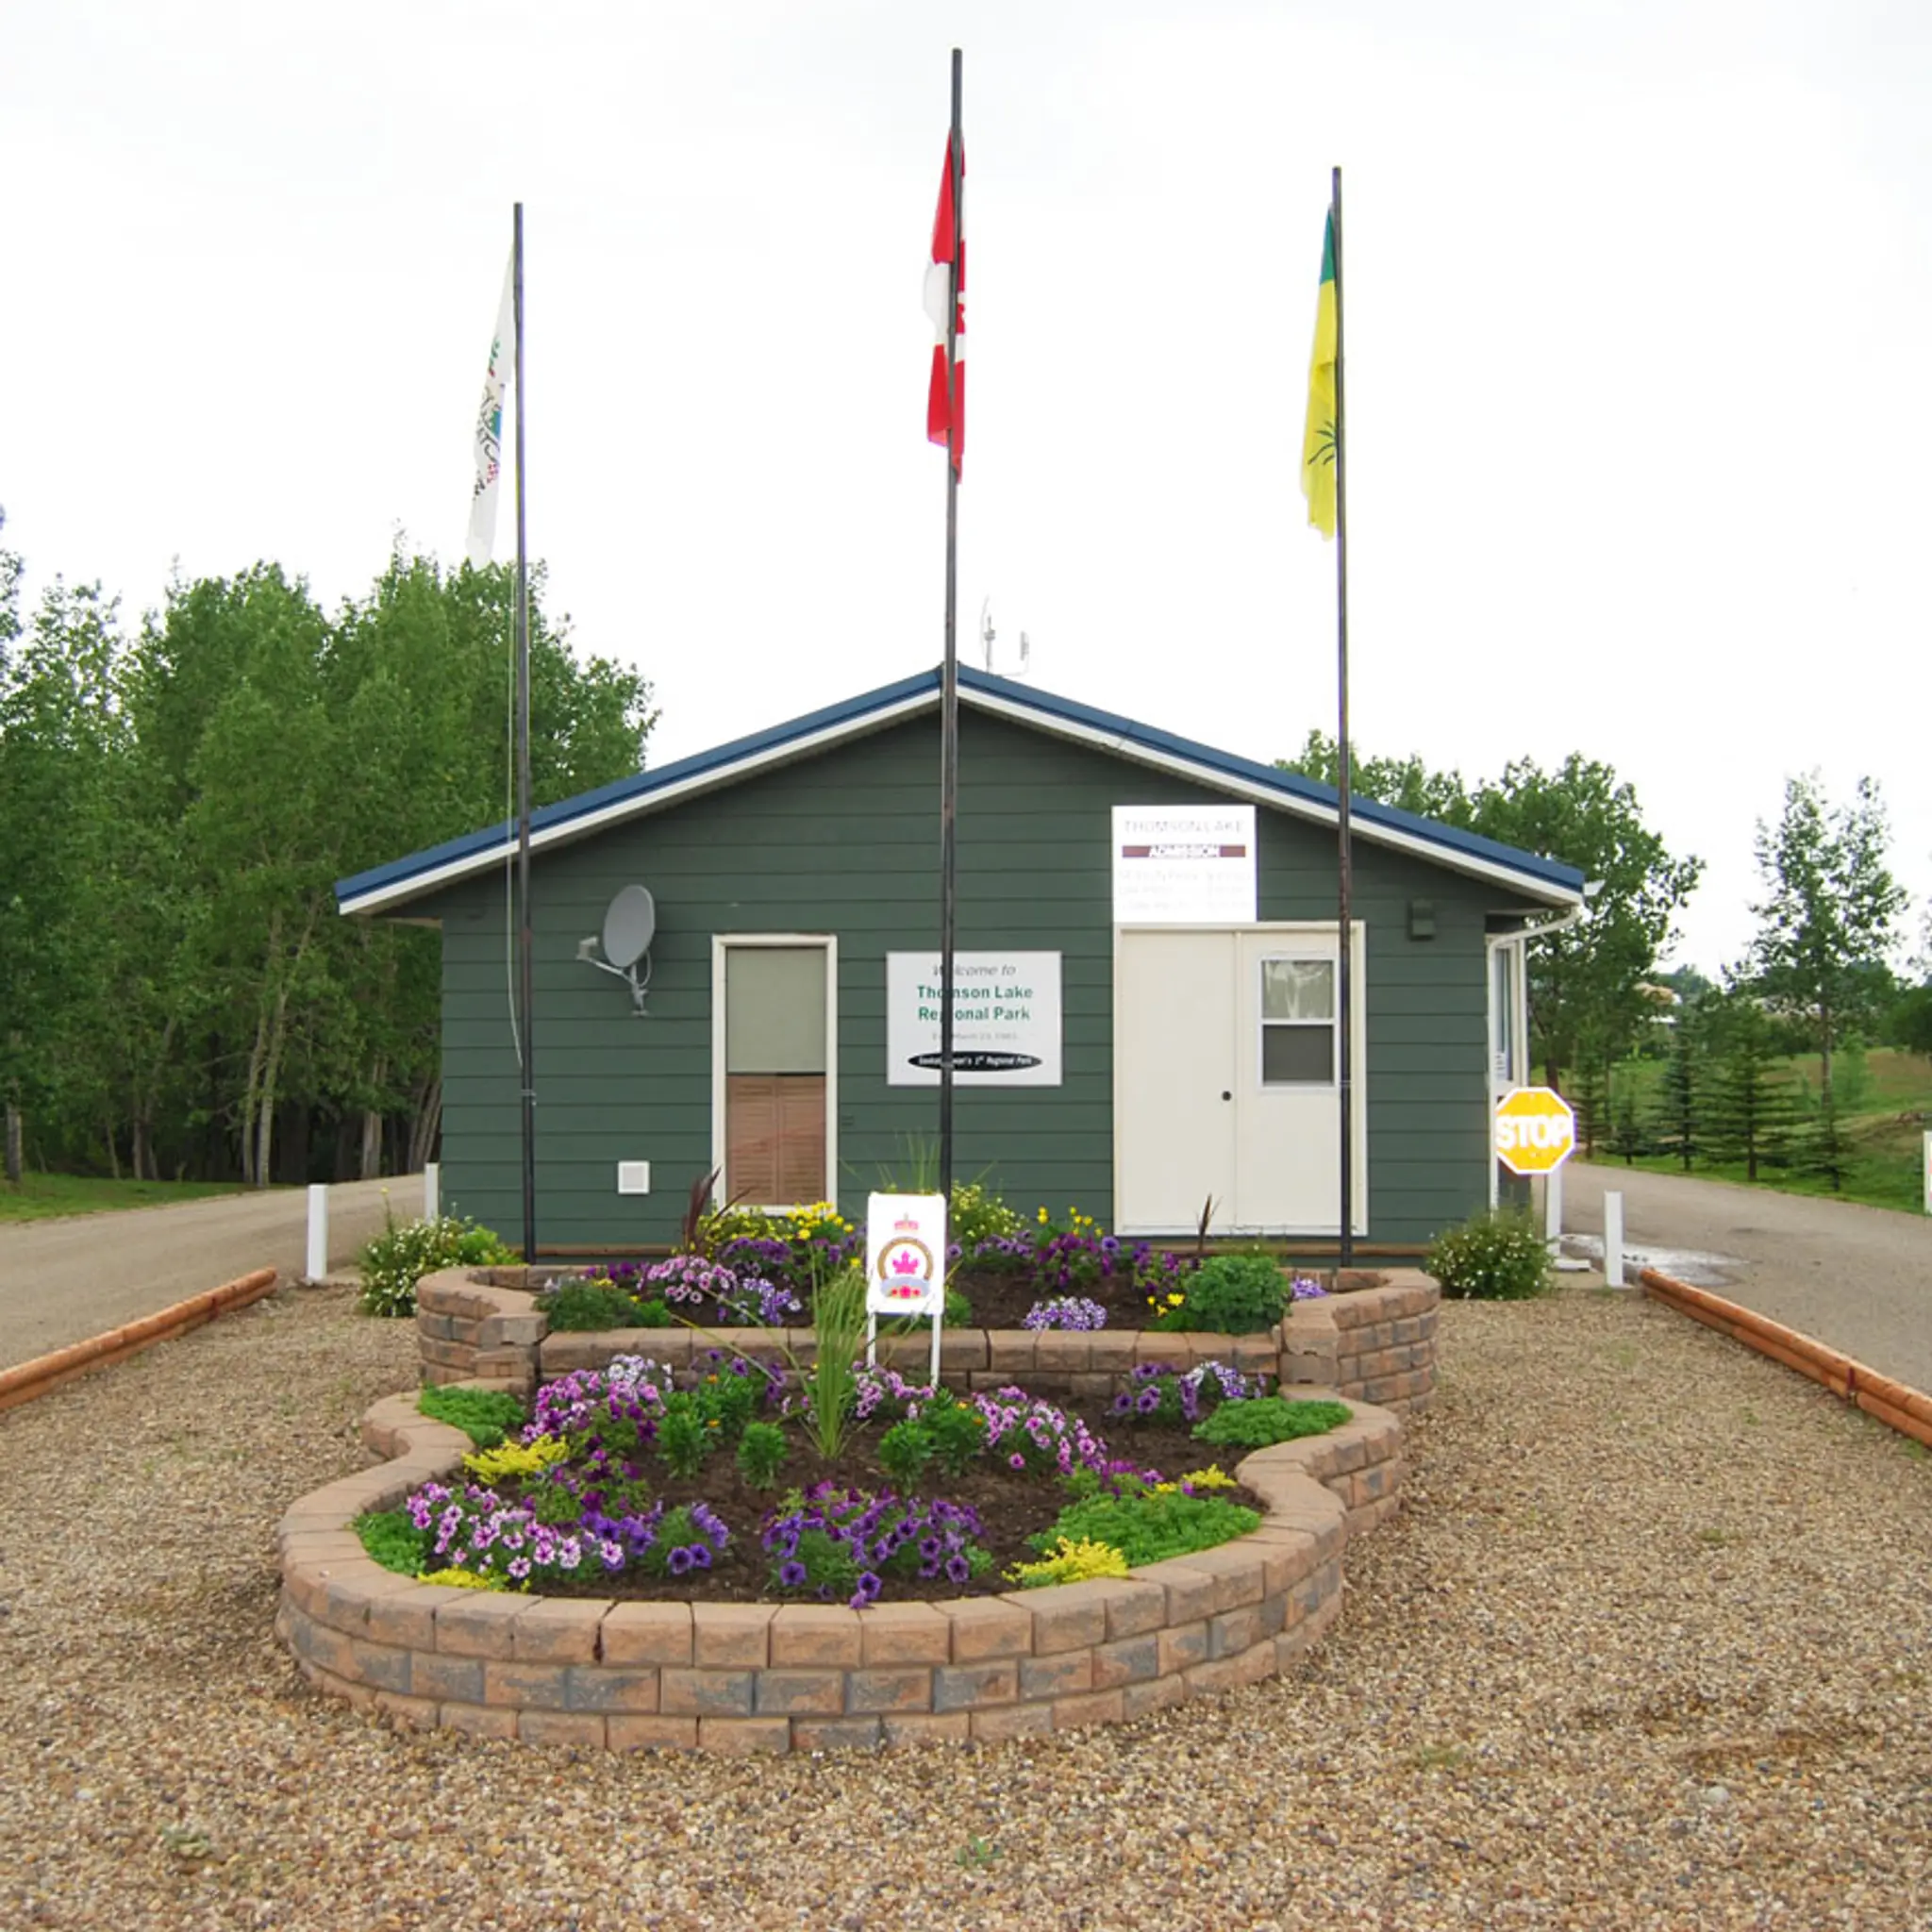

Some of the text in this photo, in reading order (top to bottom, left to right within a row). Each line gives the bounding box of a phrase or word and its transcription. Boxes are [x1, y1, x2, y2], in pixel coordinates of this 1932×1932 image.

[933, 964, 1016, 976] Wlcome to
[994, 985, 1033, 1000] Lake
[918, 1006, 1031, 1023] Reonal Park
[1495, 1115, 1570, 1150] STOP
